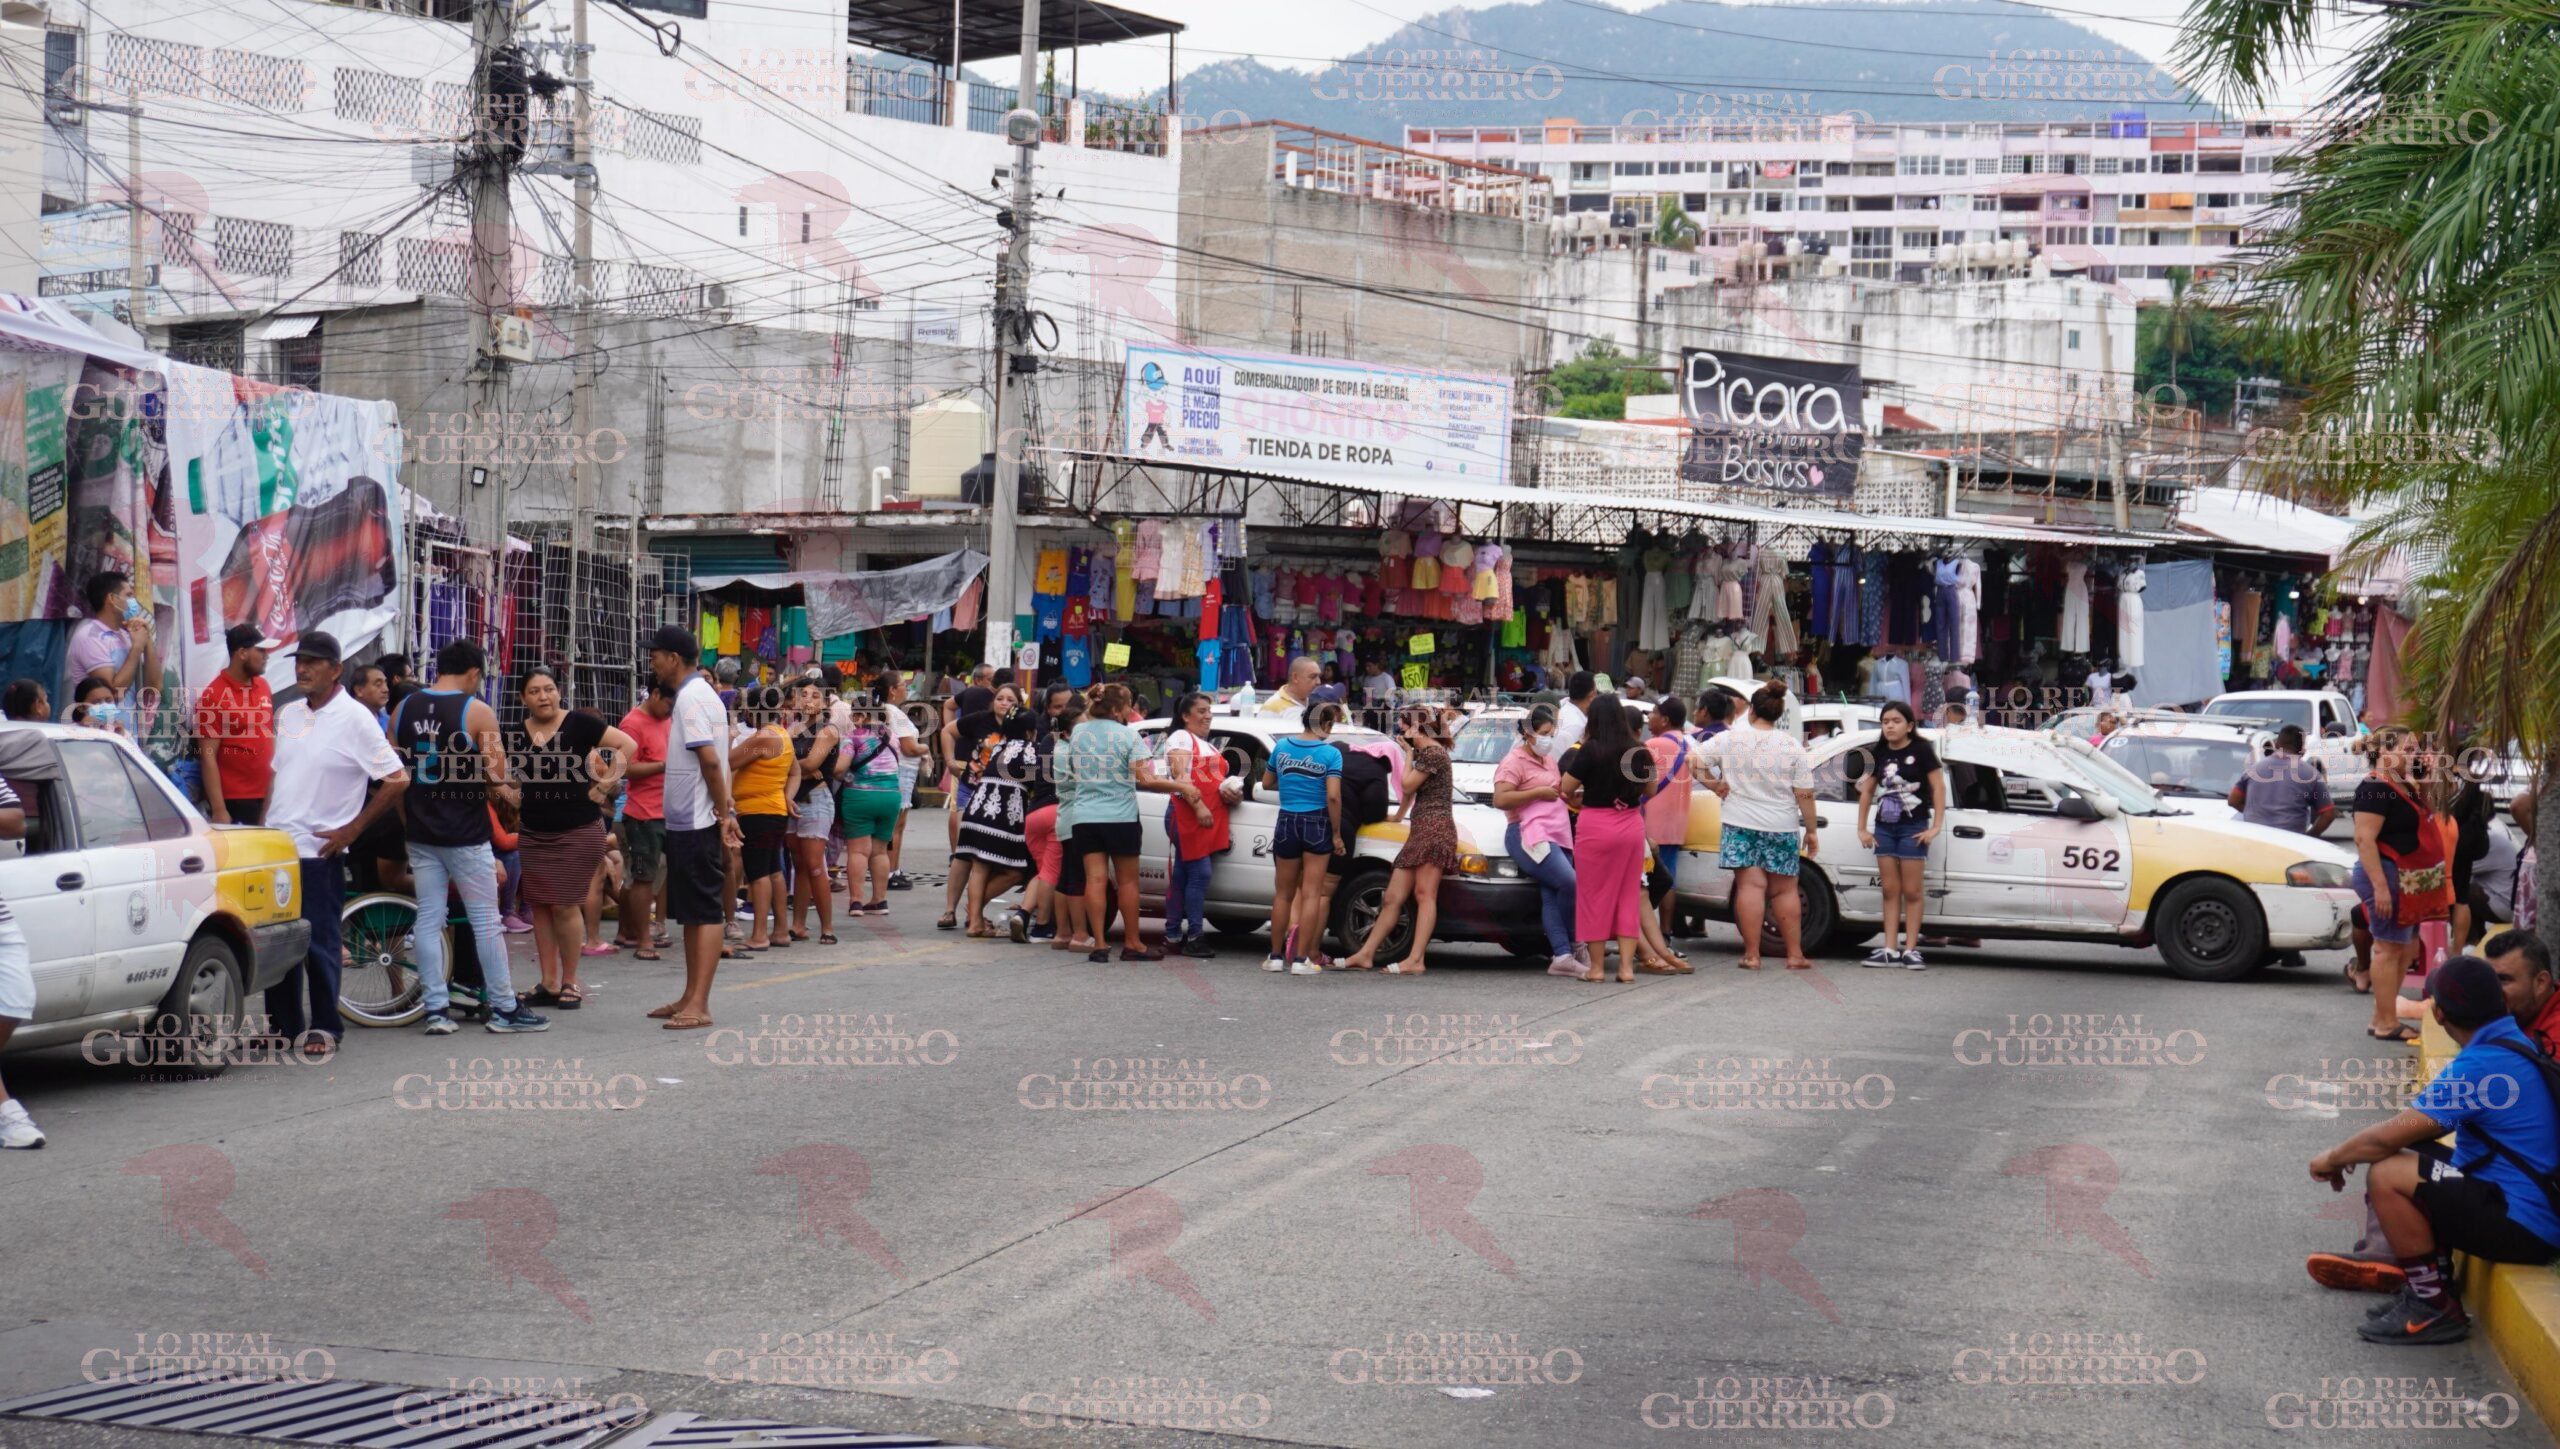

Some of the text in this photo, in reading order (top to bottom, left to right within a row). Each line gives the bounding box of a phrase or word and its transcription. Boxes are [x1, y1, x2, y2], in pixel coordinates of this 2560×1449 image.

[1183, 366, 1221, 386] AQUÍ
[1234, 370, 1410, 401] COMERCIALIZADORA DE ROPA EN GENERAL
[1182, 394, 1221, 410] EL MEJOR
[1182, 409, 1221, 430] PRECIO
[1248, 437, 1313, 460] TIENDA
[1318, 443, 1341, 461] DE
[1347, 446, 1394, 465] ROPA
[413, 719, 442, 735] BALL
[1277, 750, 1326, 772] Yankees
[2062, 845, 2121, 872] 562
